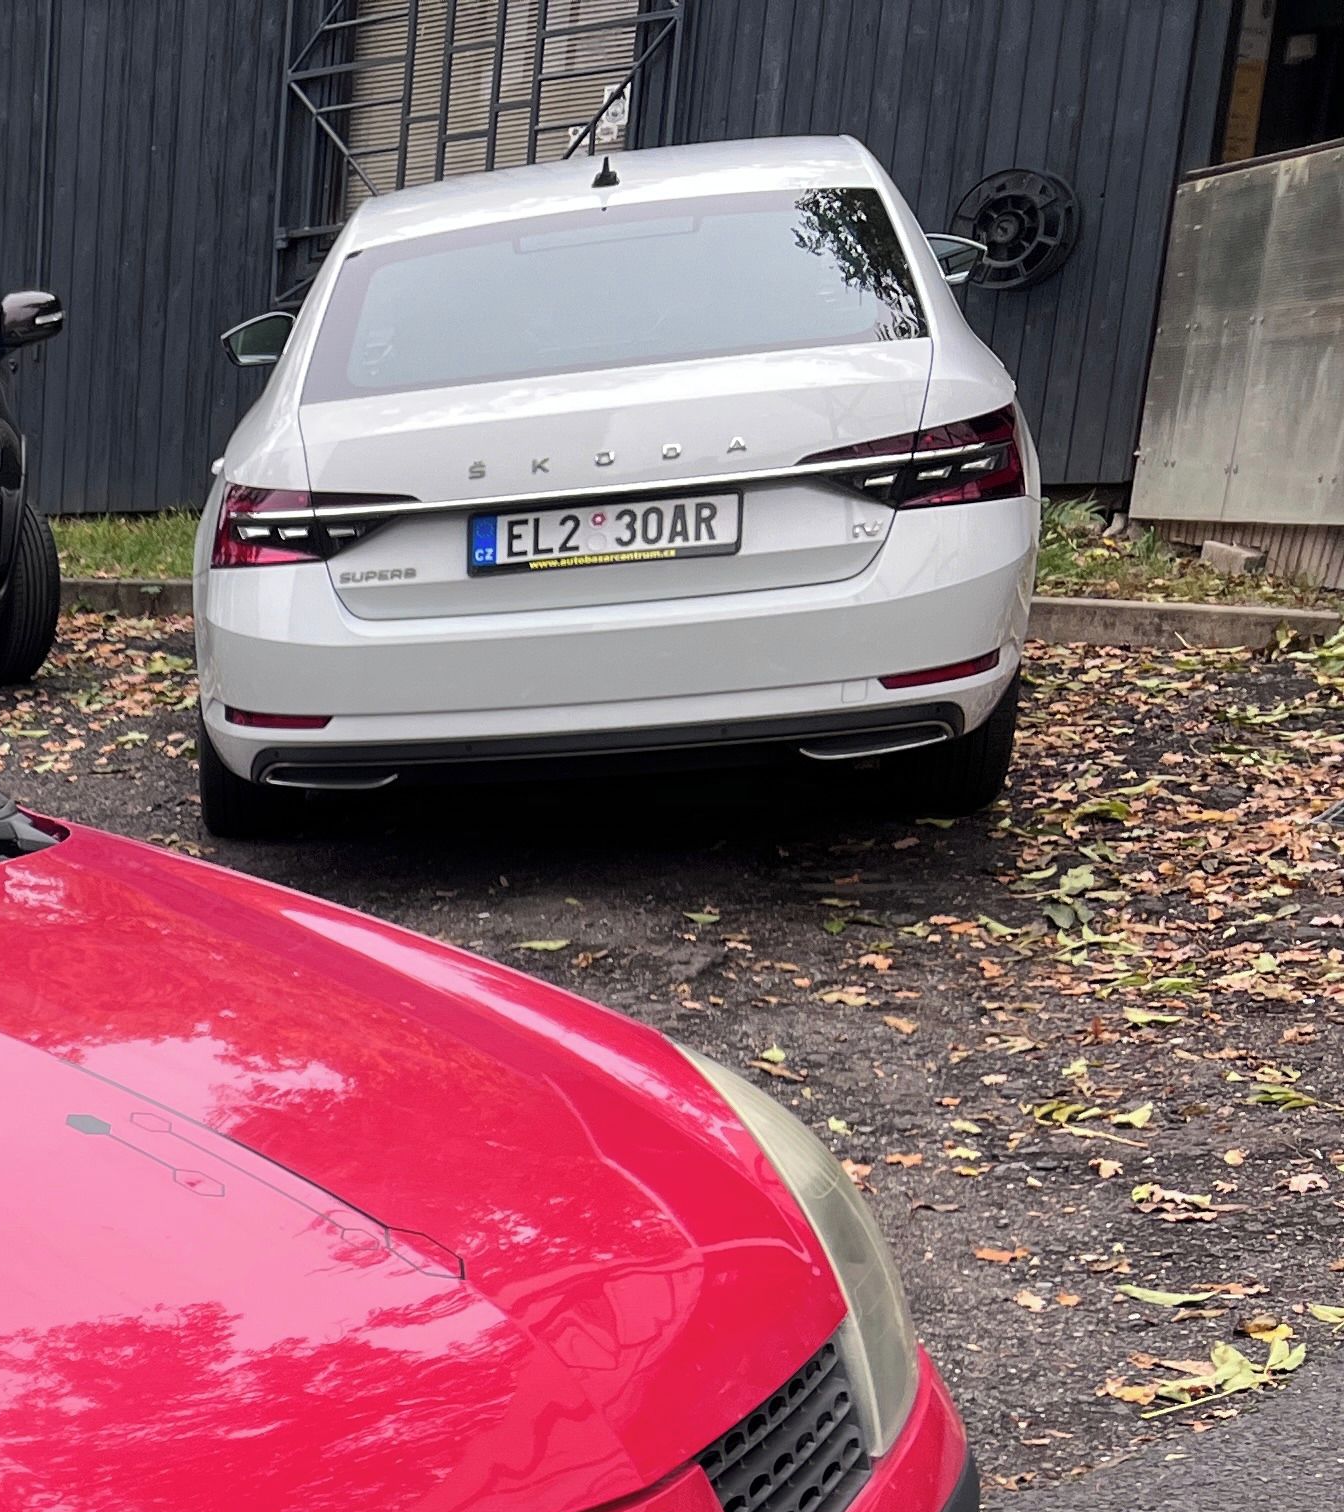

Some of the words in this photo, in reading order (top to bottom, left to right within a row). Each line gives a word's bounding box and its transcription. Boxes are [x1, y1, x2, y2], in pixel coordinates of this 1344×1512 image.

[468, 436, 747, 480] ŠKODA
[475, 547, 494, 561] CZ
[506, 514, 581, 558] EL2
[614, 501, 718, 547] 30AR
[339, 567, 417, 584] SUPERB
